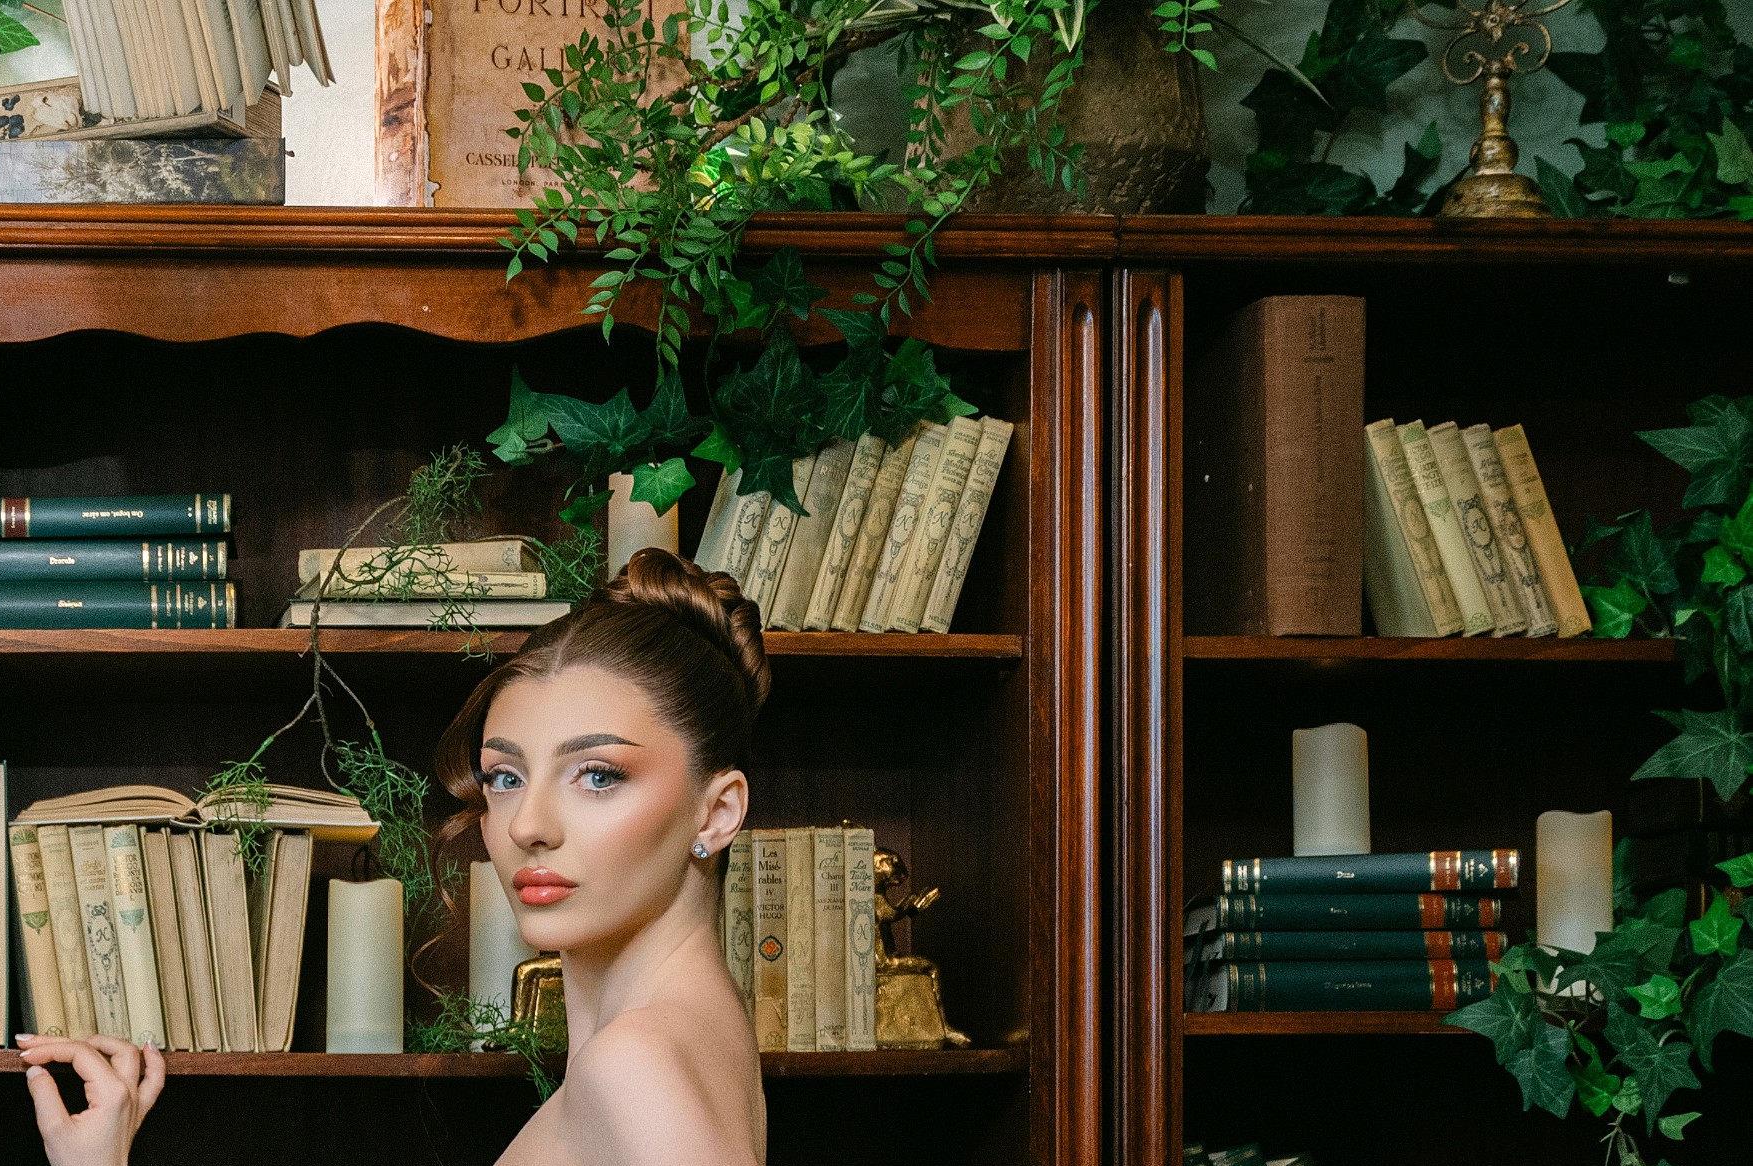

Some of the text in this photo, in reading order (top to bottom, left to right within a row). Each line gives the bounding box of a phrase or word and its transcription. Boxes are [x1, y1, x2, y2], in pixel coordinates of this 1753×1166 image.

[466, 152, 529, 169] CASSEL
[131, 510, 144, 518] Om
[762, 847, 778, 858] Les
[758, 861, 782, 872] Misé-
[854, 860, 867, 870] La
[758, 873, 782, 885] rables
[850, 870, 873, 881] Tulipe
[849, 881, 872, 892] Noire
[756, 903, 784, 912] VICTOR
